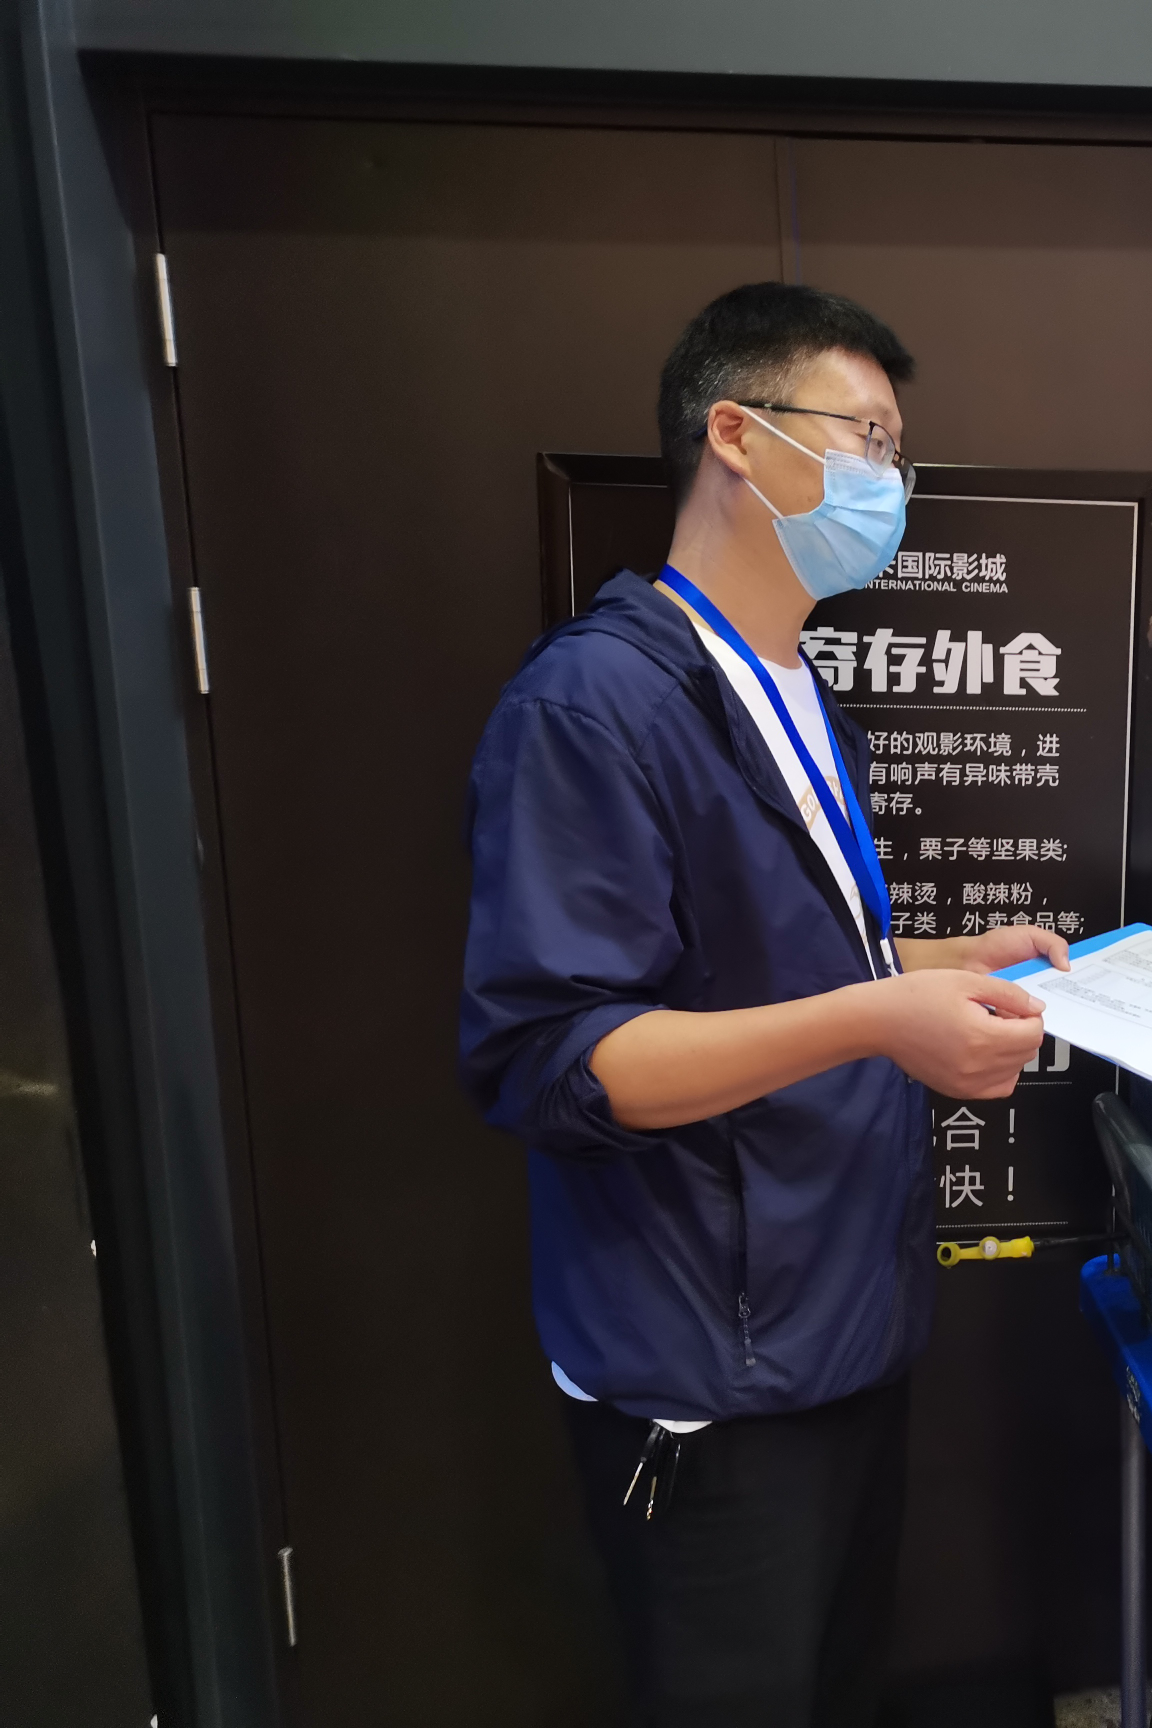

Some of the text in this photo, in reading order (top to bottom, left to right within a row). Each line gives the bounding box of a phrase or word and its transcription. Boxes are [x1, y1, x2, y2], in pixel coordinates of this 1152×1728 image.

[962, 581, 1008, 593] CINEMA
[799, 626, 1062, 696] 寄存外食
[867, 730, 1060, 757] 好的观影环境，进
[869, 761, 1060, 787] 有响声有异味带壳
[869, 791, 922, 815] 寄存。
